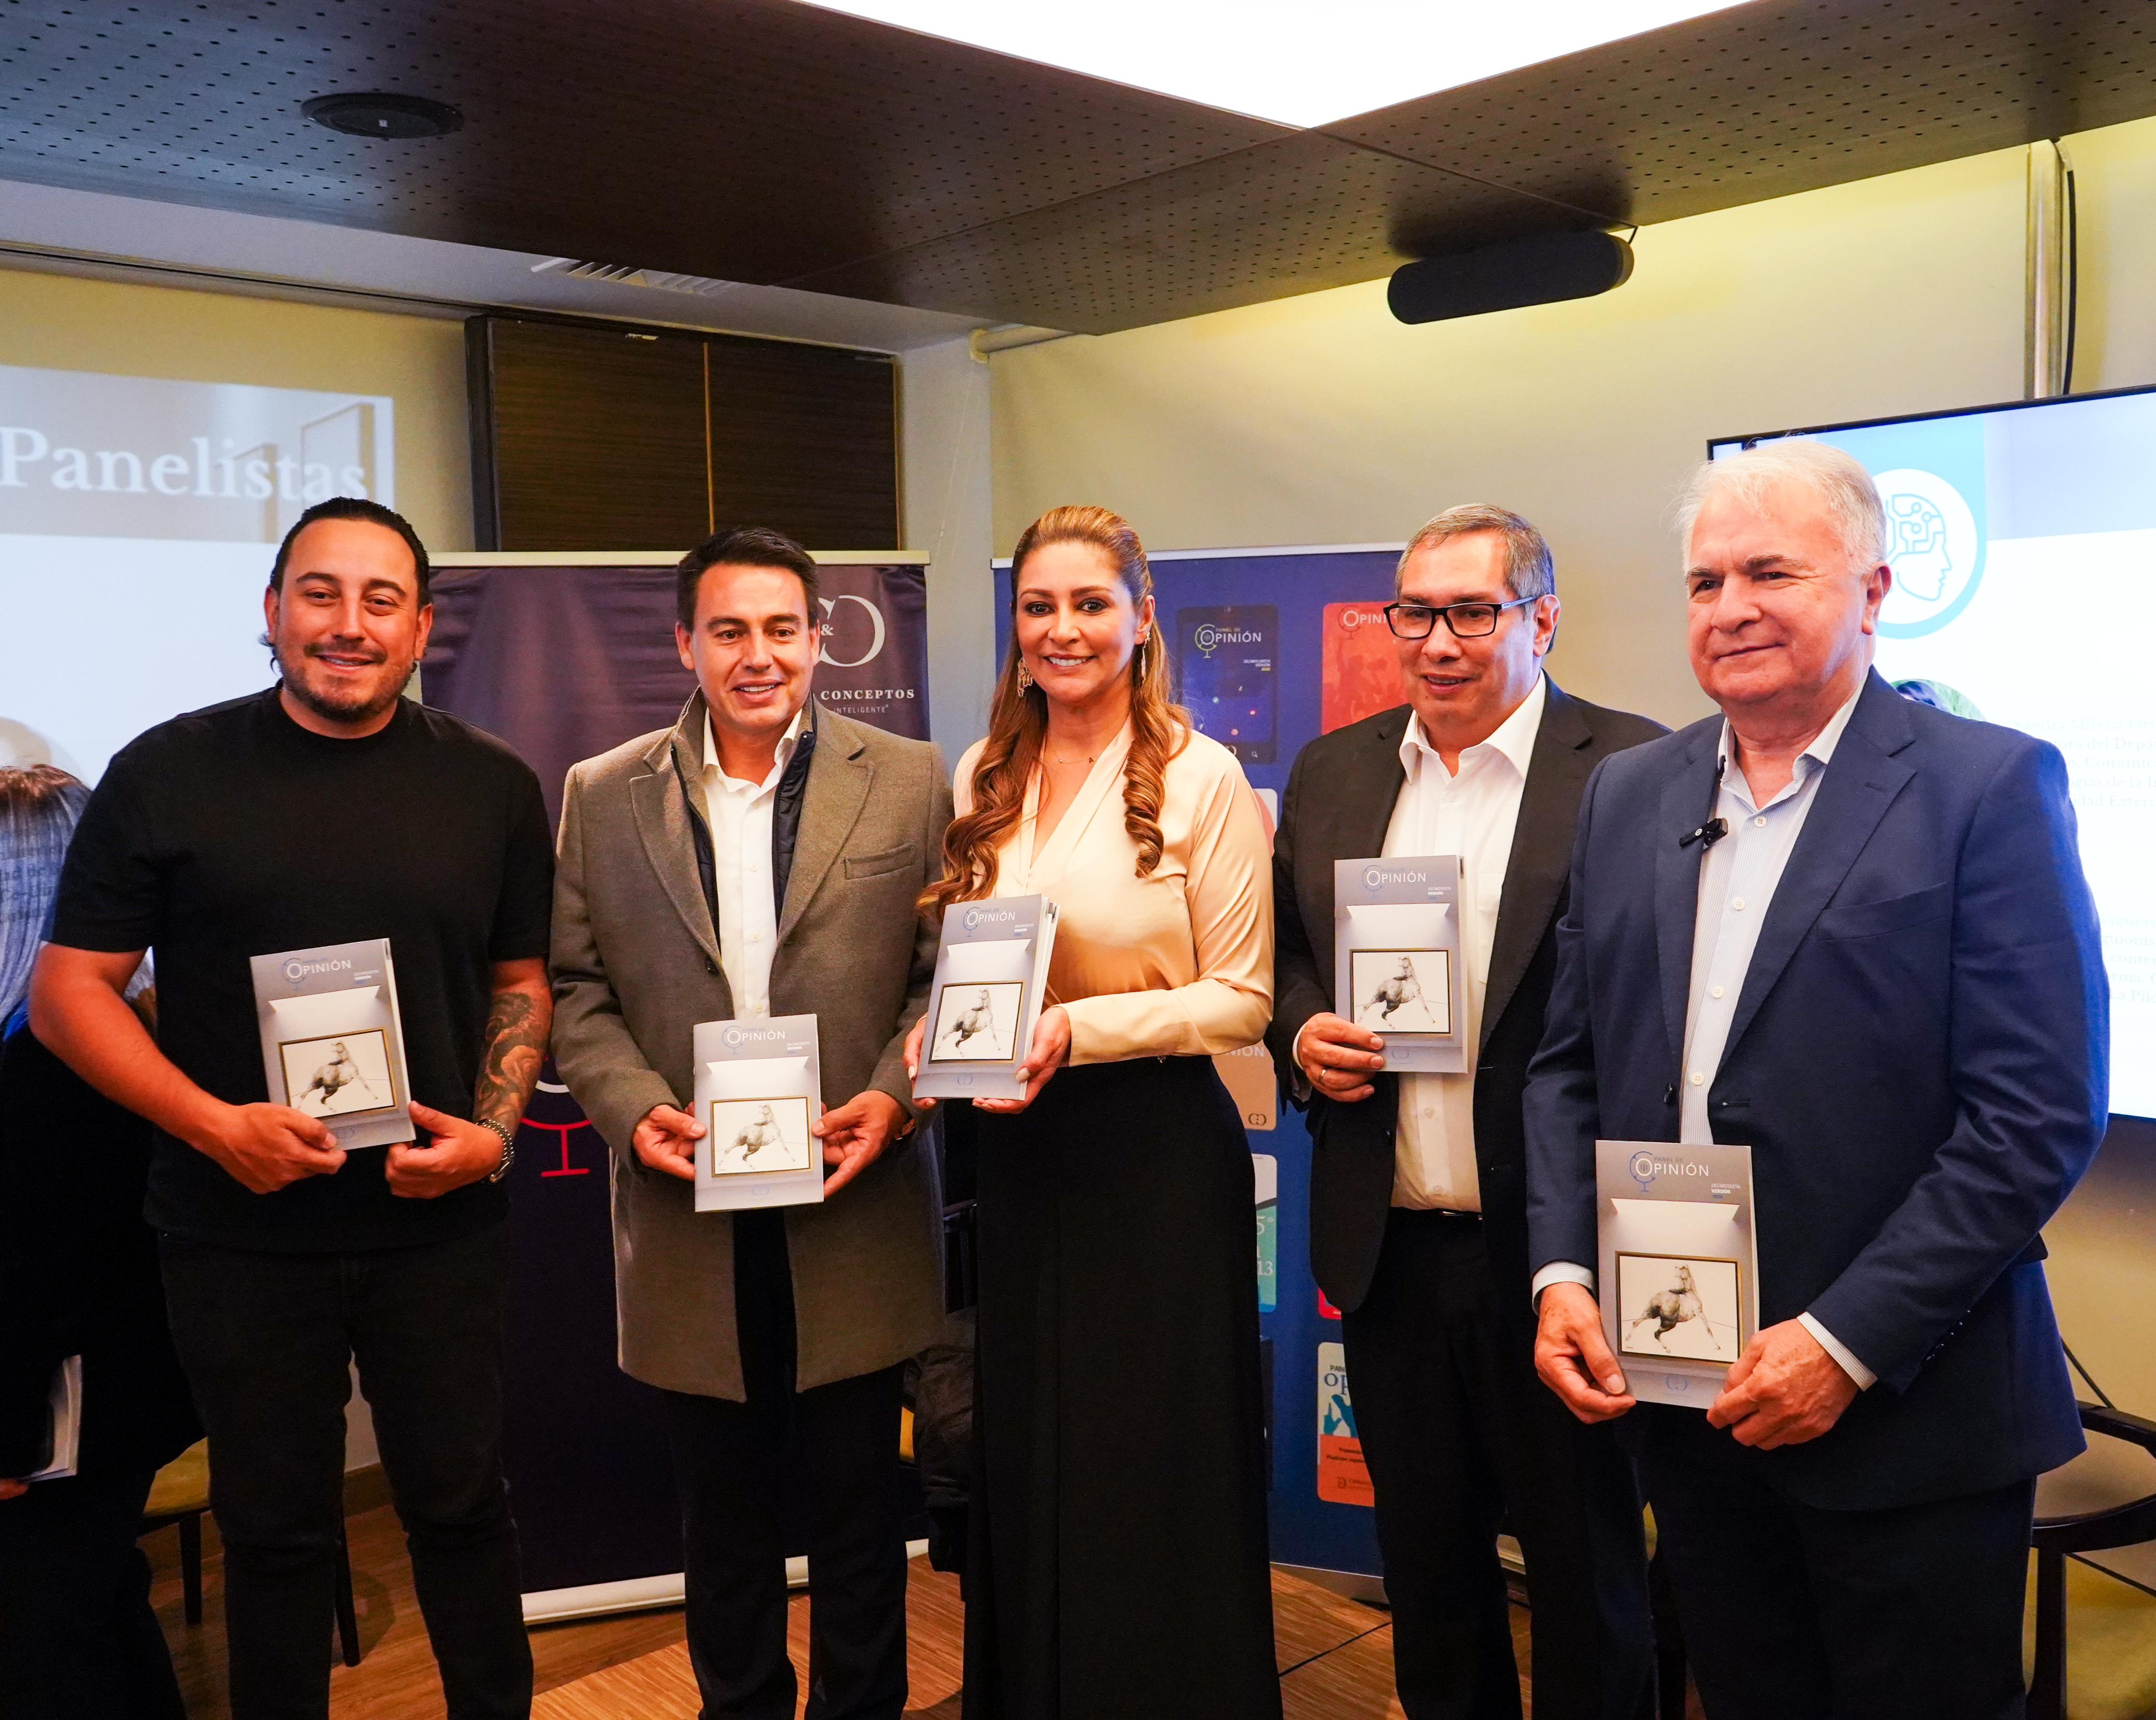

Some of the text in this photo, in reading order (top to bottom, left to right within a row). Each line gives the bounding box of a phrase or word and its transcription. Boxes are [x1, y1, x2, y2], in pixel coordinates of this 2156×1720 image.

[0, 427, 368, 501] Panelistas
[1343, 611, 1387, 627] OPINI
[1200, 630, 1261, 645] OPINIÓN
[820, 689, 915, 700] CONCEPTOS
[1367, 870, 1426, 885] OPINIÓN
[967, 911, 1015, 925] OPINIÓN
[287, 959, 351, 978] OPINIÓN
[727, 1029, 785, 1044] OPINIÓN
[1636, 1158, 1709, 1176] OPINIÓN
[1257, 1261, 1273, 1276] 13
